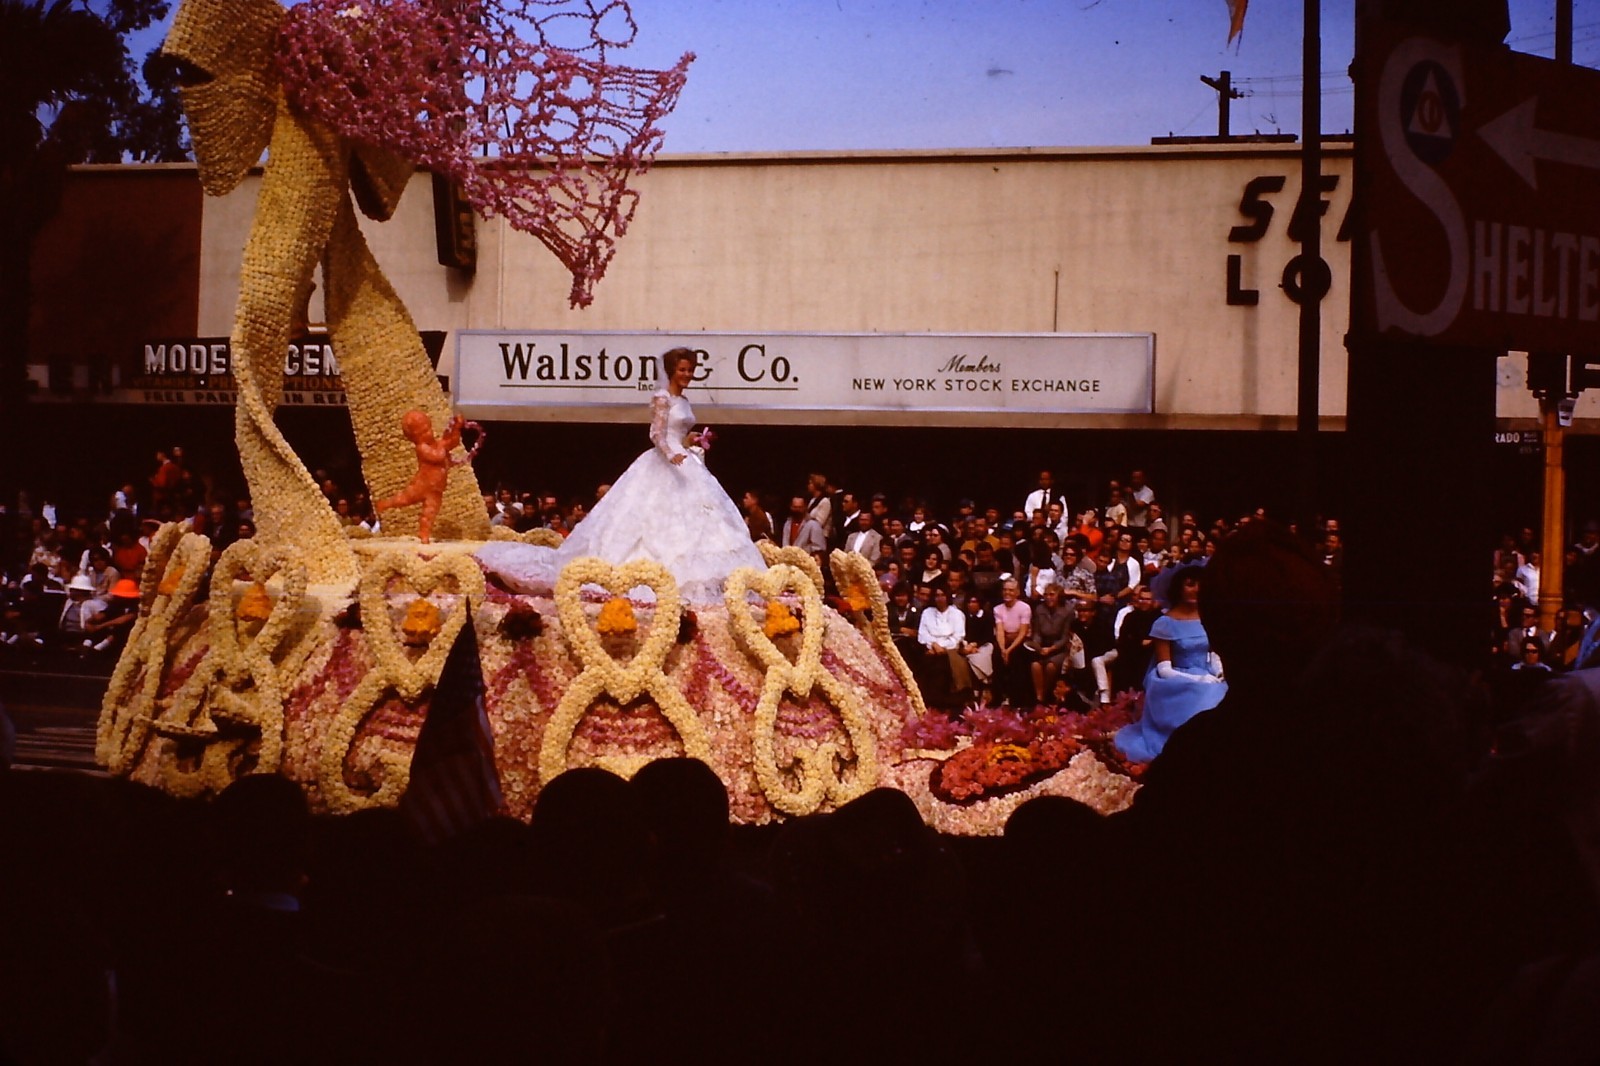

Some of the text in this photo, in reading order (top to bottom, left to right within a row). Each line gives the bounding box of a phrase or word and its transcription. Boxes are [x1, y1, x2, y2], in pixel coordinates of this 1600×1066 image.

[498, 343, 658, 381] Walston
[737, 344, 799, 382] Co.
[937, 354, 1001, 373] Members
[852, 378, 1101, 392] NEW YORK STOCK EXCHANGE
